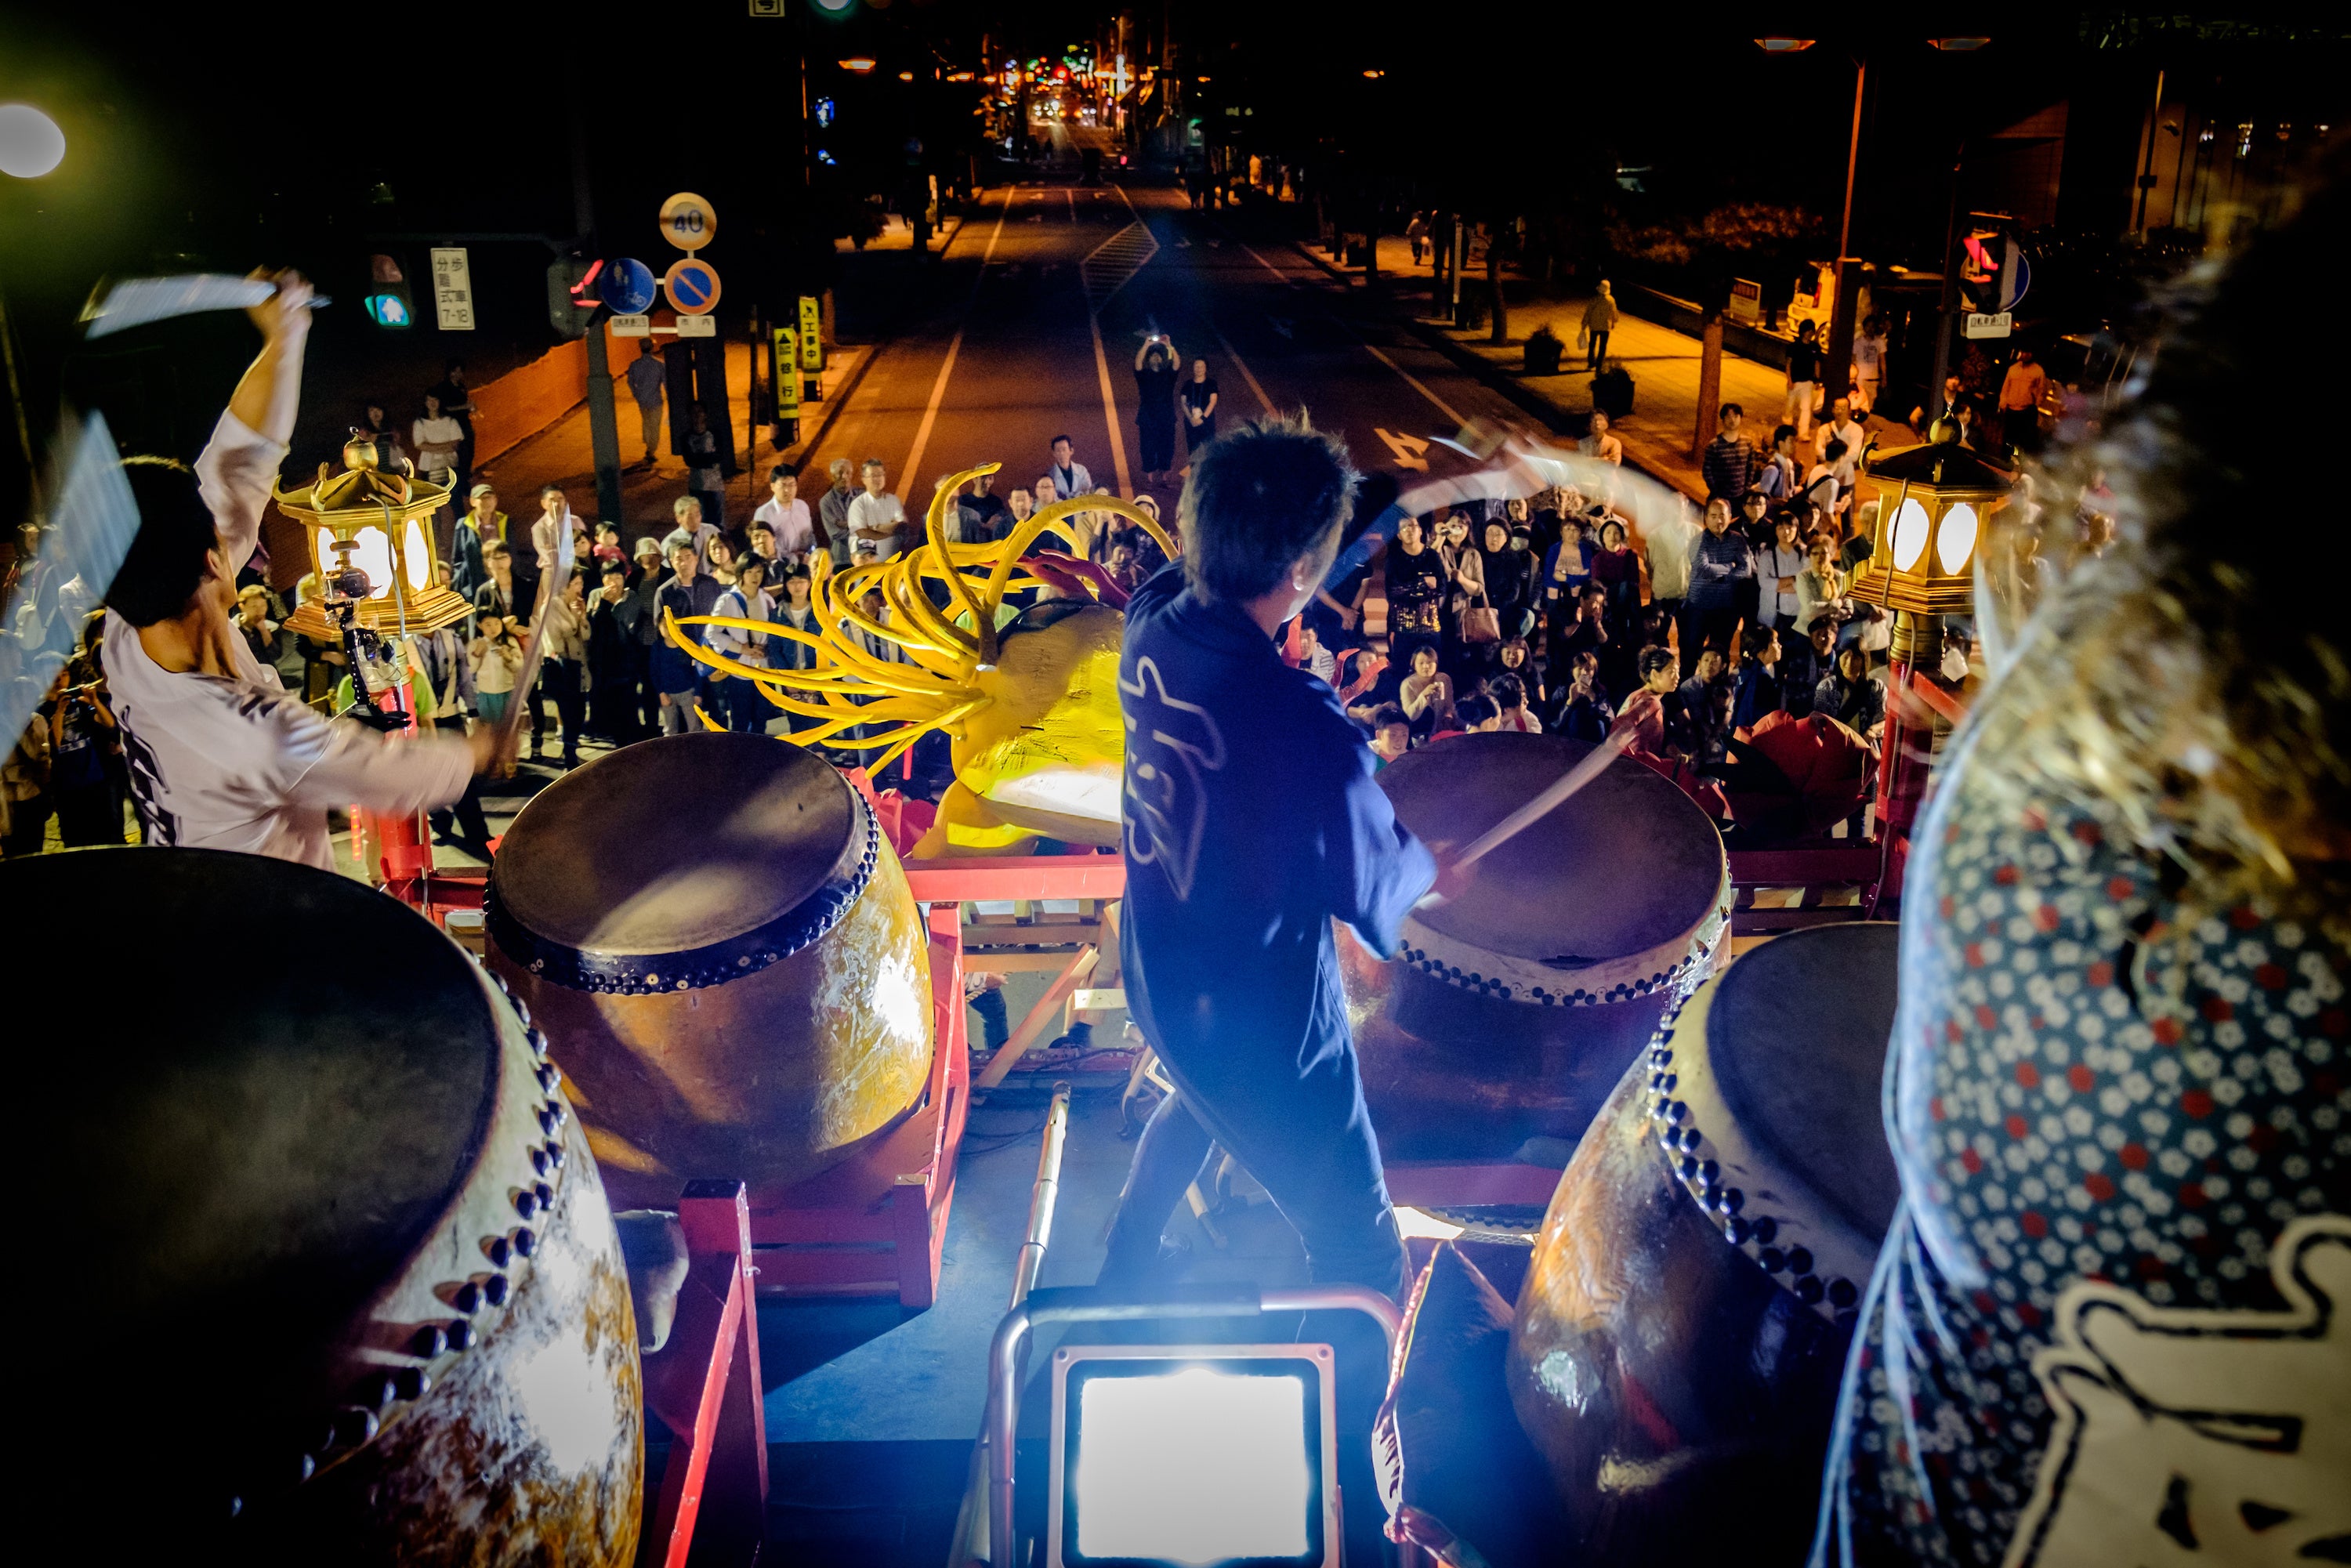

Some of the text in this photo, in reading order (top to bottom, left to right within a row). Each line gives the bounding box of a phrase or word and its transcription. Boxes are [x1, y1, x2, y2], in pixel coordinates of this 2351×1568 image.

[674, 209, 703, 233] 40
[442, 309, 469, 323] 7-18
[805, 322, 817, 359] 工事中
[780, 362, 794, 398] 徐行
